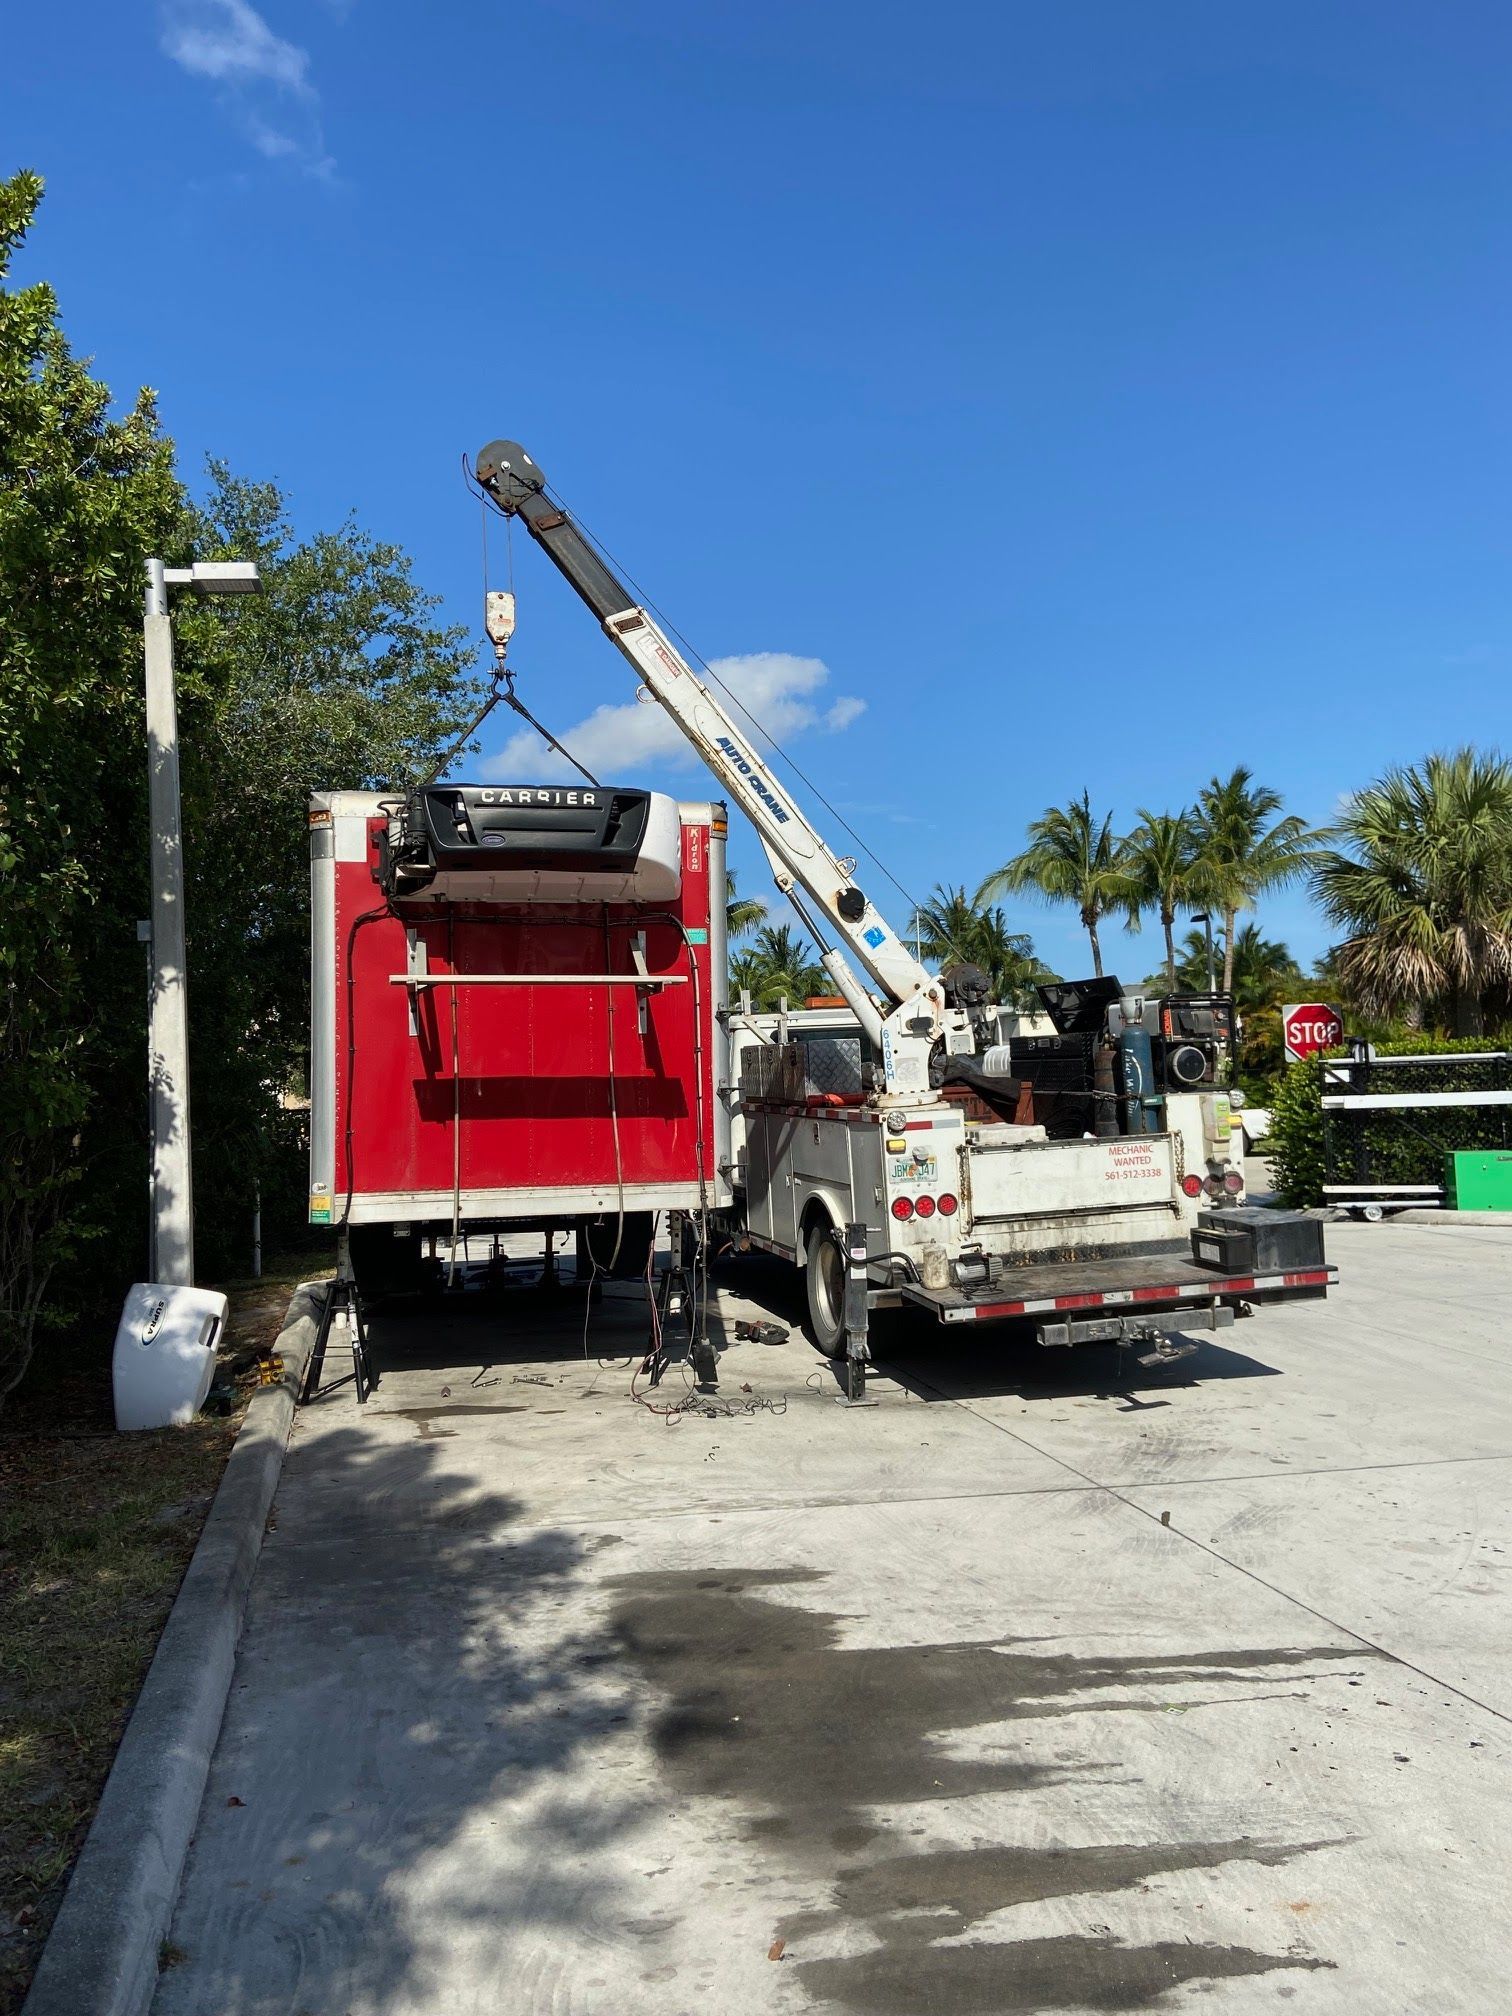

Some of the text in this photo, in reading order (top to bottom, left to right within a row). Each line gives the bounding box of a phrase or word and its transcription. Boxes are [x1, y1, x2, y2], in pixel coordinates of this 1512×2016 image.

[715, 737, 790, 824] AUTO CRANE
[481, 789, 596, 805] CARRIER
[690, 828, 699, 870] Kidron
[1289, 1021, 1339, 1044] STOP
[883, 1029, 895, 1080] 6406H
[1109, 1144, 1154, 1156] MECHANIC
[1114, 1155, 1151, 1167] WANTED
[1105, 1168, 1162, 1180] 561-512-3338
[148, 1301, 164, 1334] SUPRA
